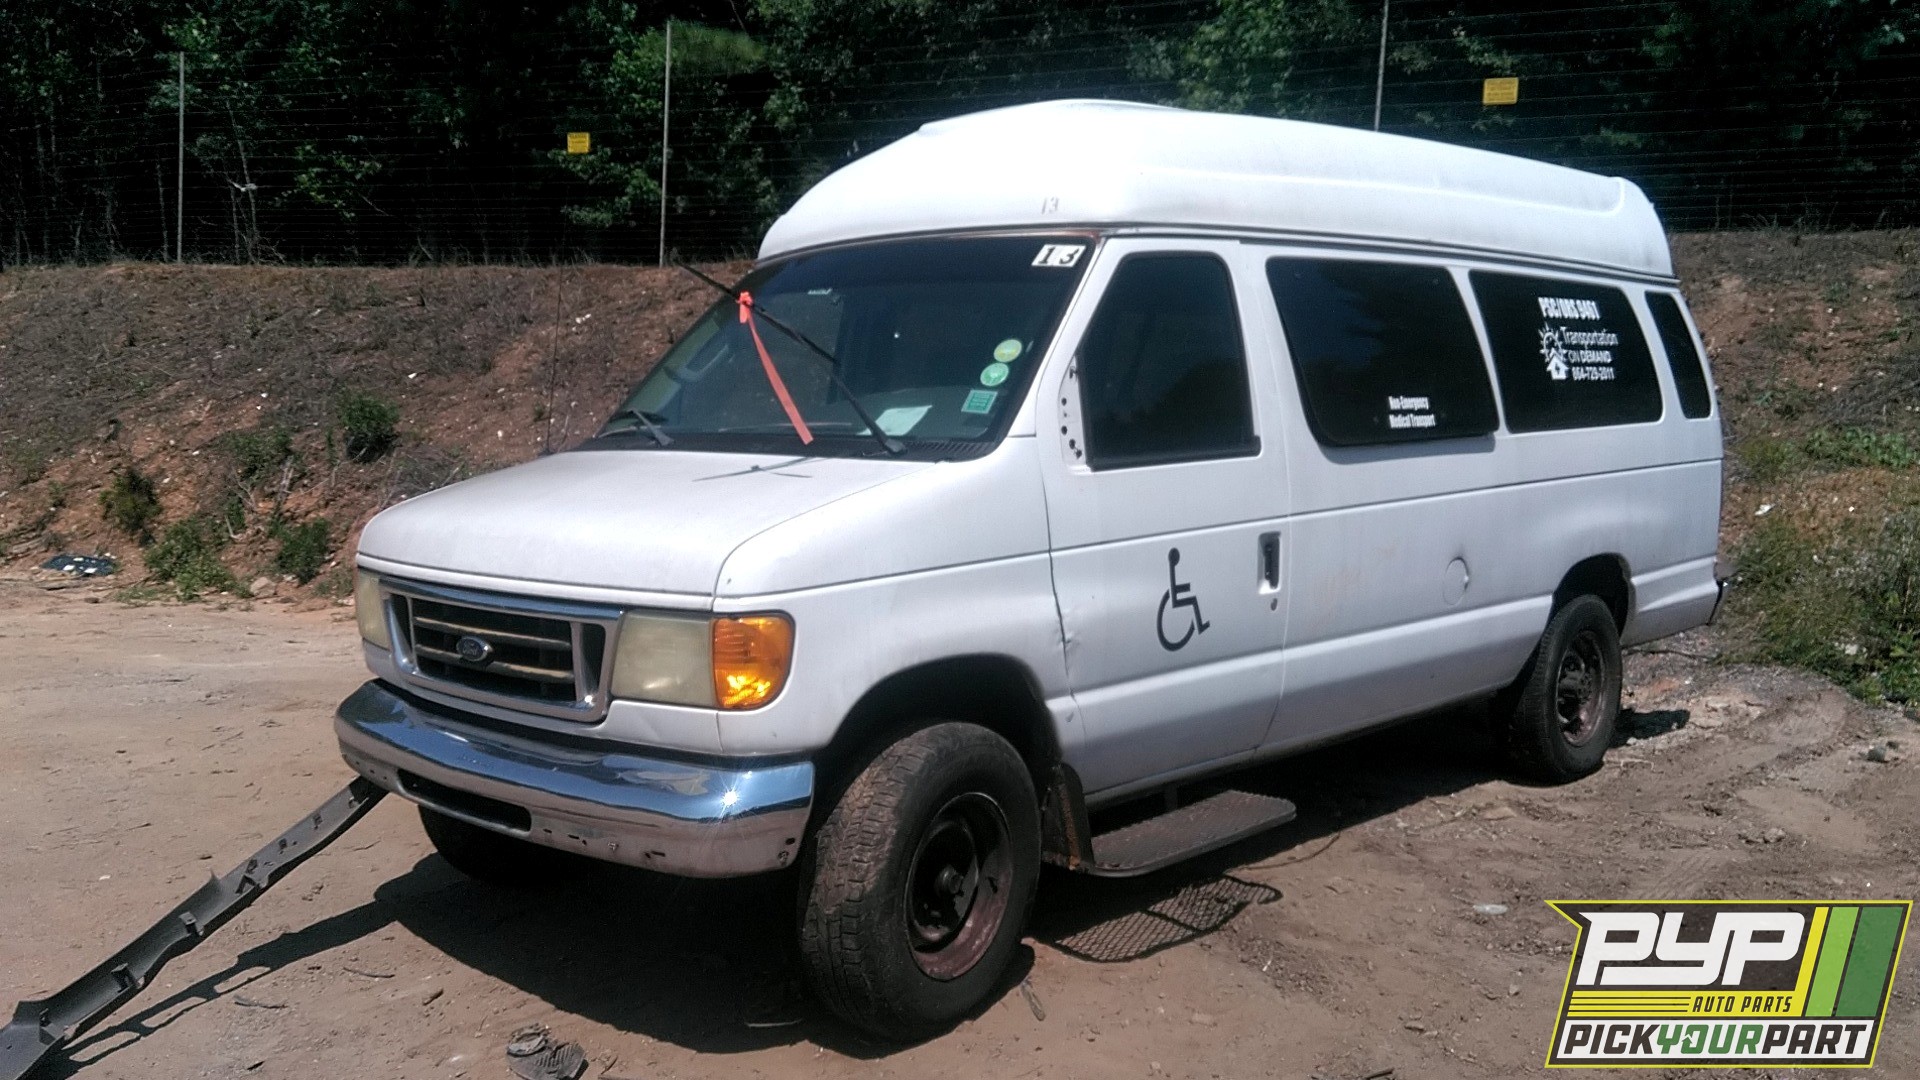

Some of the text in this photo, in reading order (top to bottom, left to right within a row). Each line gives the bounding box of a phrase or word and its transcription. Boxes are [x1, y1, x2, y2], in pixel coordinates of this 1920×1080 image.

[1038, 246, 1080, 265] 13
[1560, 326, 1619, 349] Transportation
[1567, 349, 1612, 364] ON DEMAND
[1388, 395, 1429, 411] Non-Emergency
[1389, 413, 1436, 428] Medical Transport
